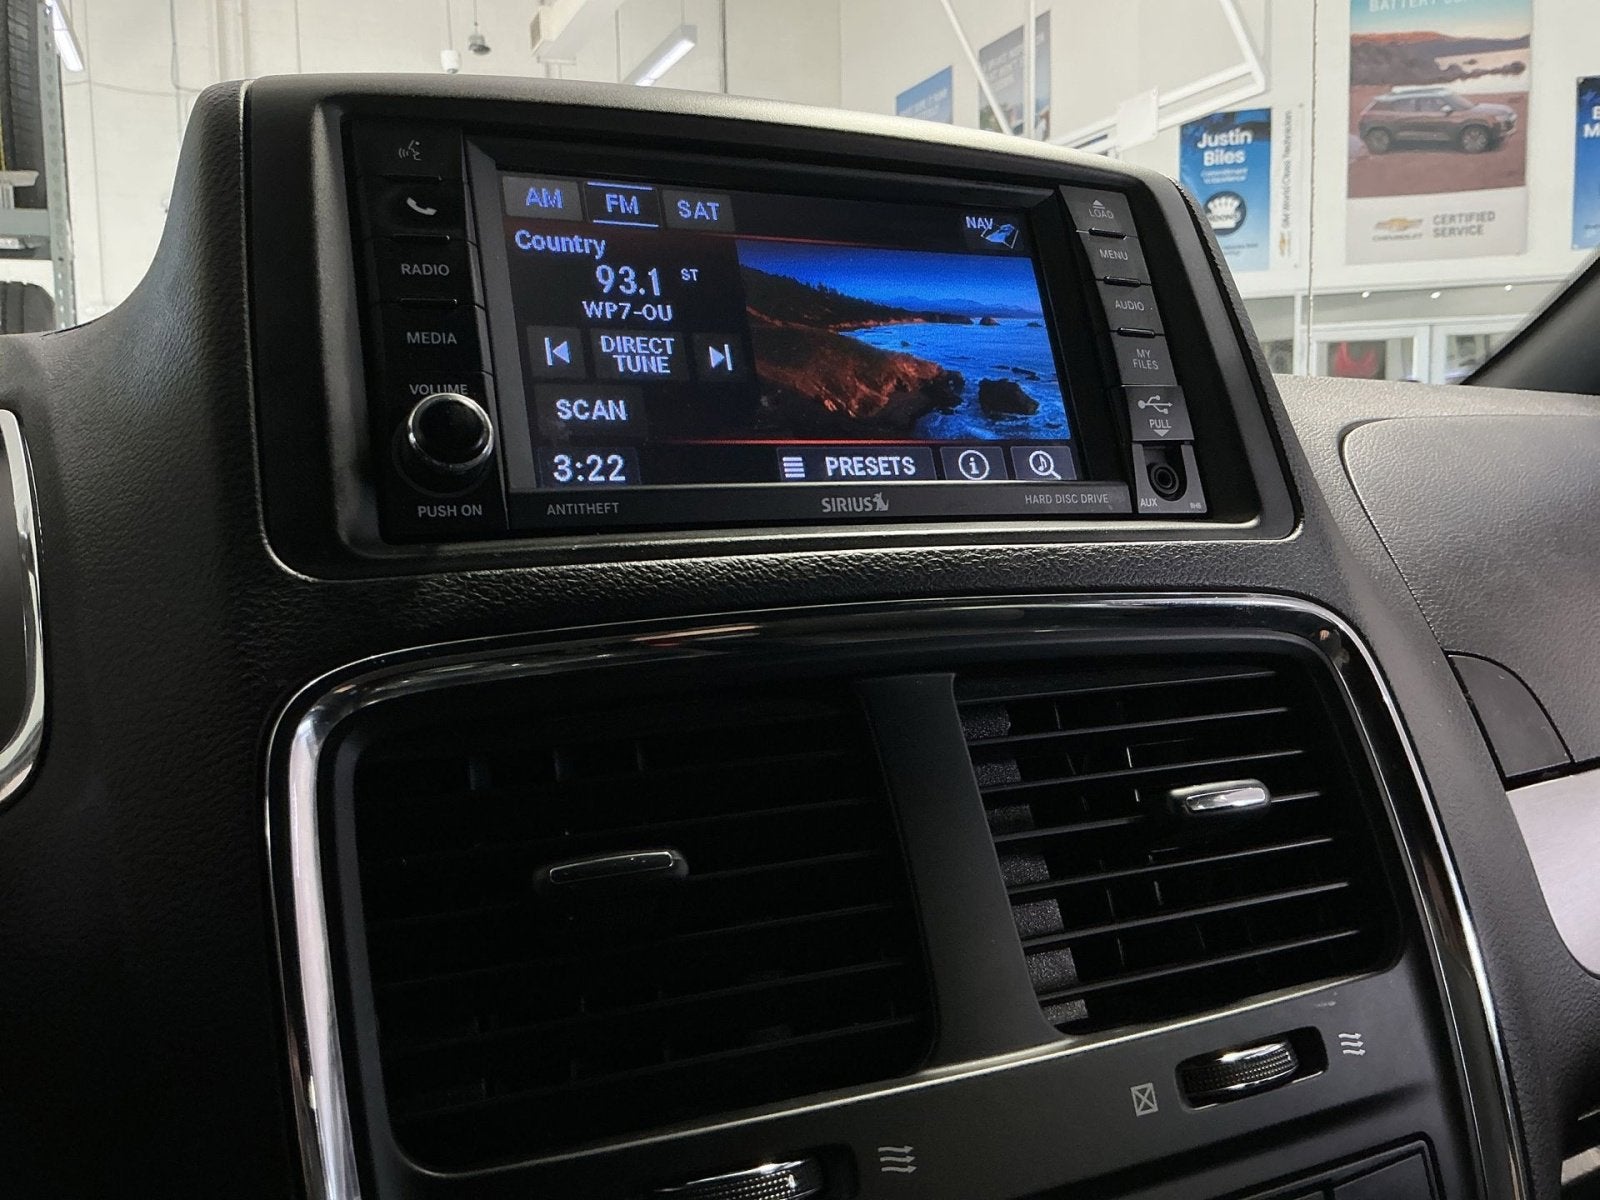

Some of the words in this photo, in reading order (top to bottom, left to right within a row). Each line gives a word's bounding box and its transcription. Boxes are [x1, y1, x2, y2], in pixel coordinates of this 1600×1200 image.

[1196, 128, 1253, 149] Justin
[1203, 148, 1246, 167] Biles
[525, 186, 564, 210] AM
[605, 193, 640, 216] FM
[677, 199, 720, 222] SAT
[1088, 208, 1115, 220] LOAD
[1432, 210, 1496, 226] CERTIFIED
[965, 215, 994, 232] NAV
[1432, 224, 1485, 238] SERVICE
[514, 229, 607, 259] Country
[1100, 248, 1129, 261] MENU
[401, 263, 451, 278] RADIO
[596, 264, 661, 296] 93.1
[681, 268, 699, 282] ST
[582, 300, 674, 322] WP7-OU
[1115, 299, 1145, 312] AUDIO
[406, 331, 458, 345] MEDIA
[600, 335, 675, 356] DIRECT
[1136, 348, 1152, 360] MY
[613, 354, 671, 374] TUNE
[1132, 358, 1160, 371] FILES
[409, 383, 468, 396] VOLUME
[556, 399, 628, 421] SCAN
[1149, 418, 1172, 430] PULL
[553, 455, 627, 483] 3:22
[825, 455, 917, 477] PRESETS
[821, 496, 873, 513] SIRIUS
[1025, 494, 1053, 505] HARD
[1055, 493, 1078, 504] DISC
[1080, 493, 1110, 504] DRIVE
[1140, 498, 1158, 508] AUX
[418, 505, 459, 518] PUSH
[463, 504, 483, 517] ON
[546, 502, 620, 516] ANTITHEFT
